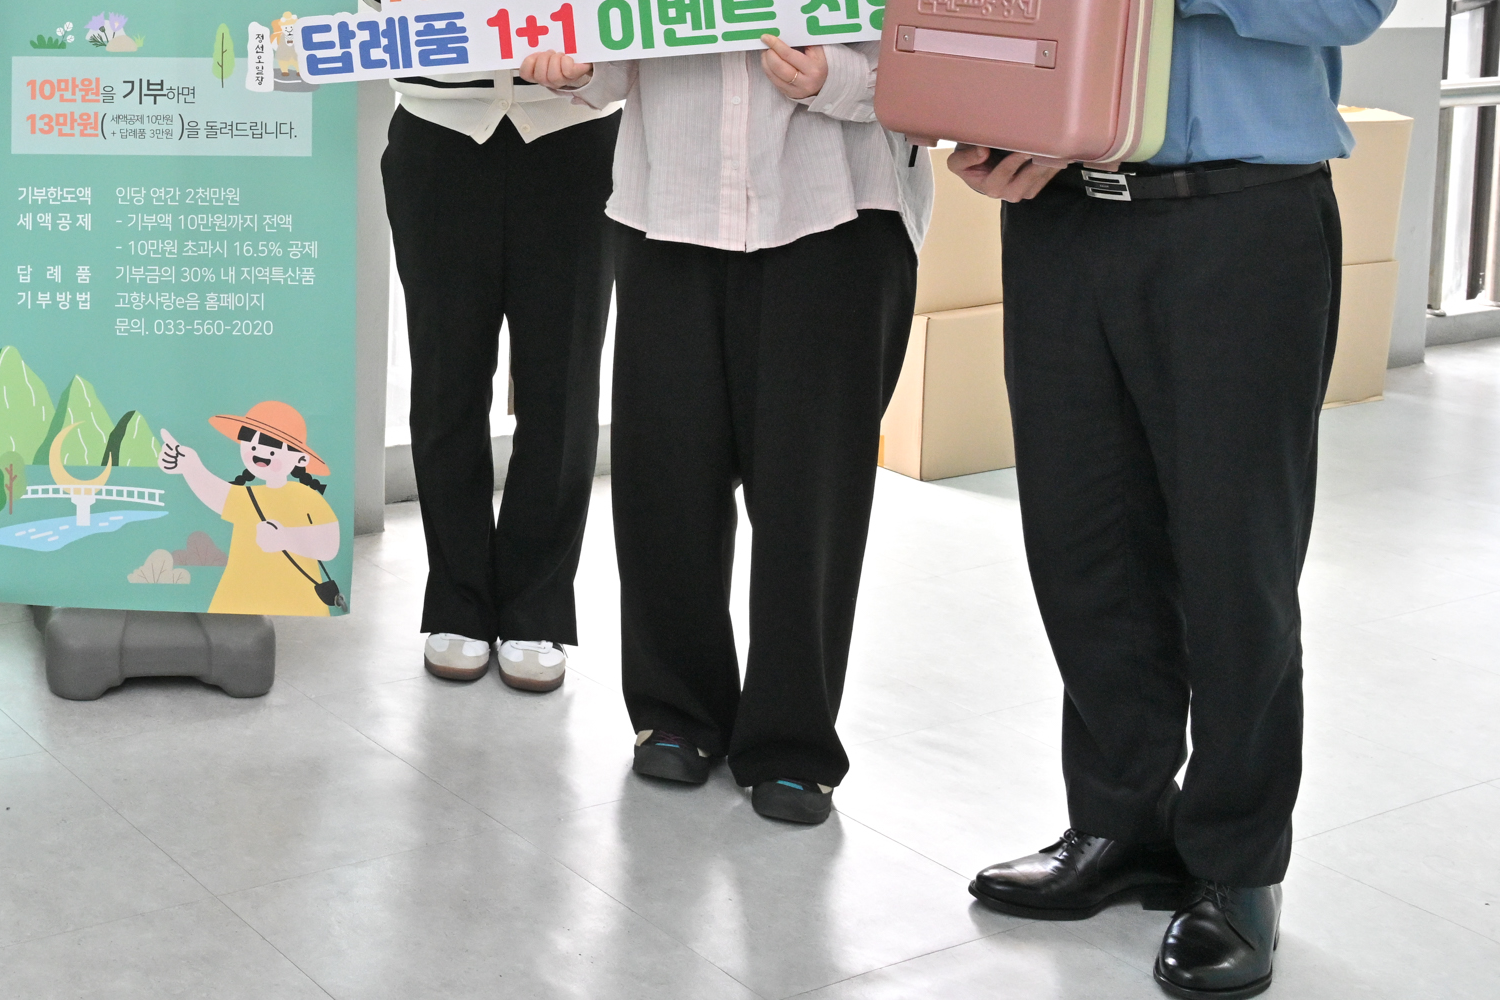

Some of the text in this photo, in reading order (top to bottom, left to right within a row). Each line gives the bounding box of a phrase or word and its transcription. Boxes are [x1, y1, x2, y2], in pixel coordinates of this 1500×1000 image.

[301, 10, 470, 77] 답례품
[486, 2, 578, 60] 1+1
[255, 34, 264, 85] 정선오일장
[27, 77, 195, 105] 10만원을 기부하면
[111, 114, 173, 125] 세액공제 10만원
[120, 128, 146, 139] 답례품
[150, 129, 173, 139] 3만원
[204, 121, 297, 139] 돌려드립니다.
[18, 186, 239, 205] 기부한도액 인당 연간 2천만원
[128, 213, 172, 231] 기부액
[179, 214, 257, 232] 10만원까지
[263, 214, 292, 232] 전액
[129, 240, 177, 257] 10만원
[183, 240, 227, 258] 초과시
[234, 242, 282, 256] 16.5%
[288, 241, 317, 259] 공제
[116, 265, 175, 283] 기부금의
[181, 267, 215, 282] 30%
[221, 267, 235, 284] 내
[241, 267, 315, 285] 지역특산품
[115, 292, 200, 310] 고향사랑e음
[205, 292, 264, 310] 홈페이지
[115, 318, 273, 335] 문의. 033-560-2020
